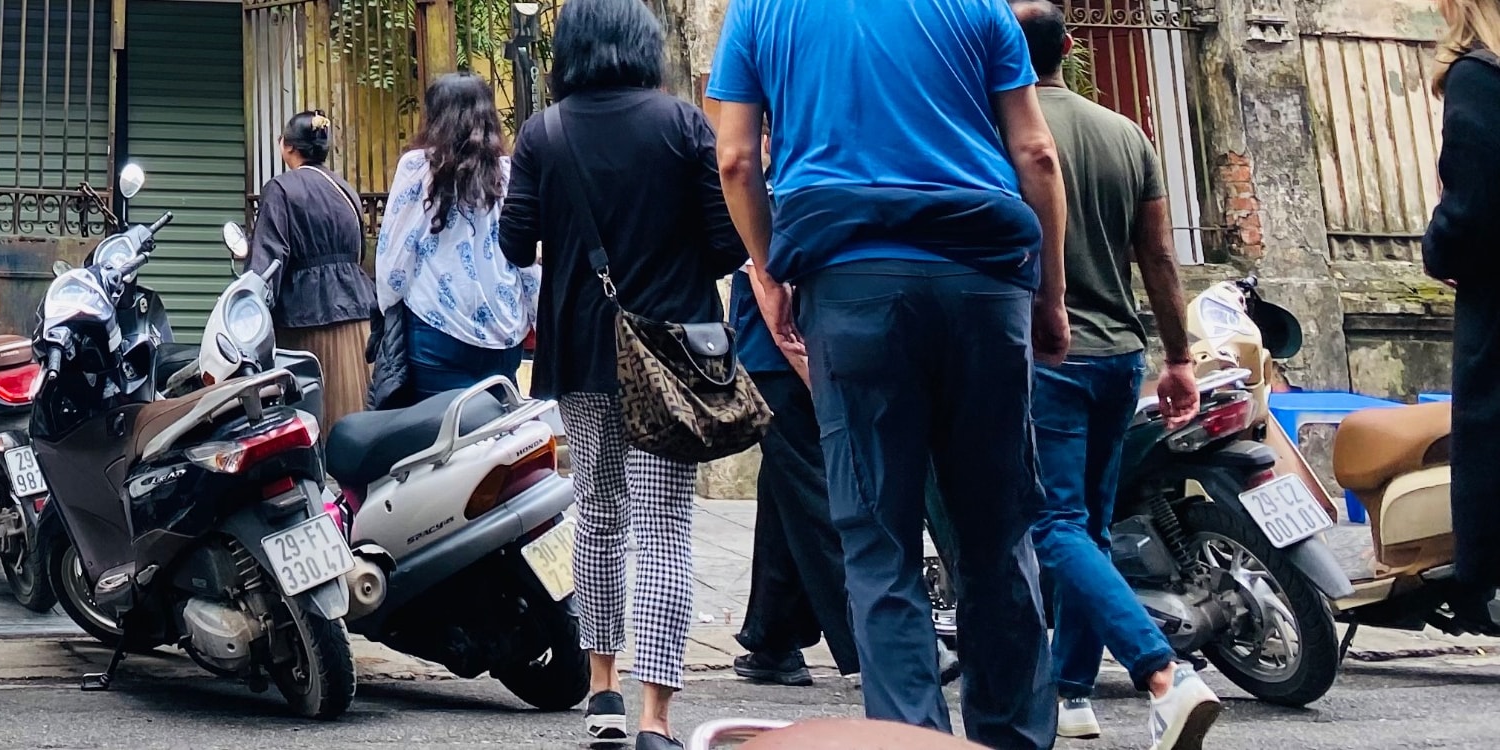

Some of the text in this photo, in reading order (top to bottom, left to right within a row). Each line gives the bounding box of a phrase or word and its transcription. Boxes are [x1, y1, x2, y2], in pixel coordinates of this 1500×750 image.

[516, 439, 543, 457] HONDA
[274, 521, 331, 562] 29-F1
[1265, 503, 1326, 543] 001.01
[281, 543, 345, 590] 330.47
